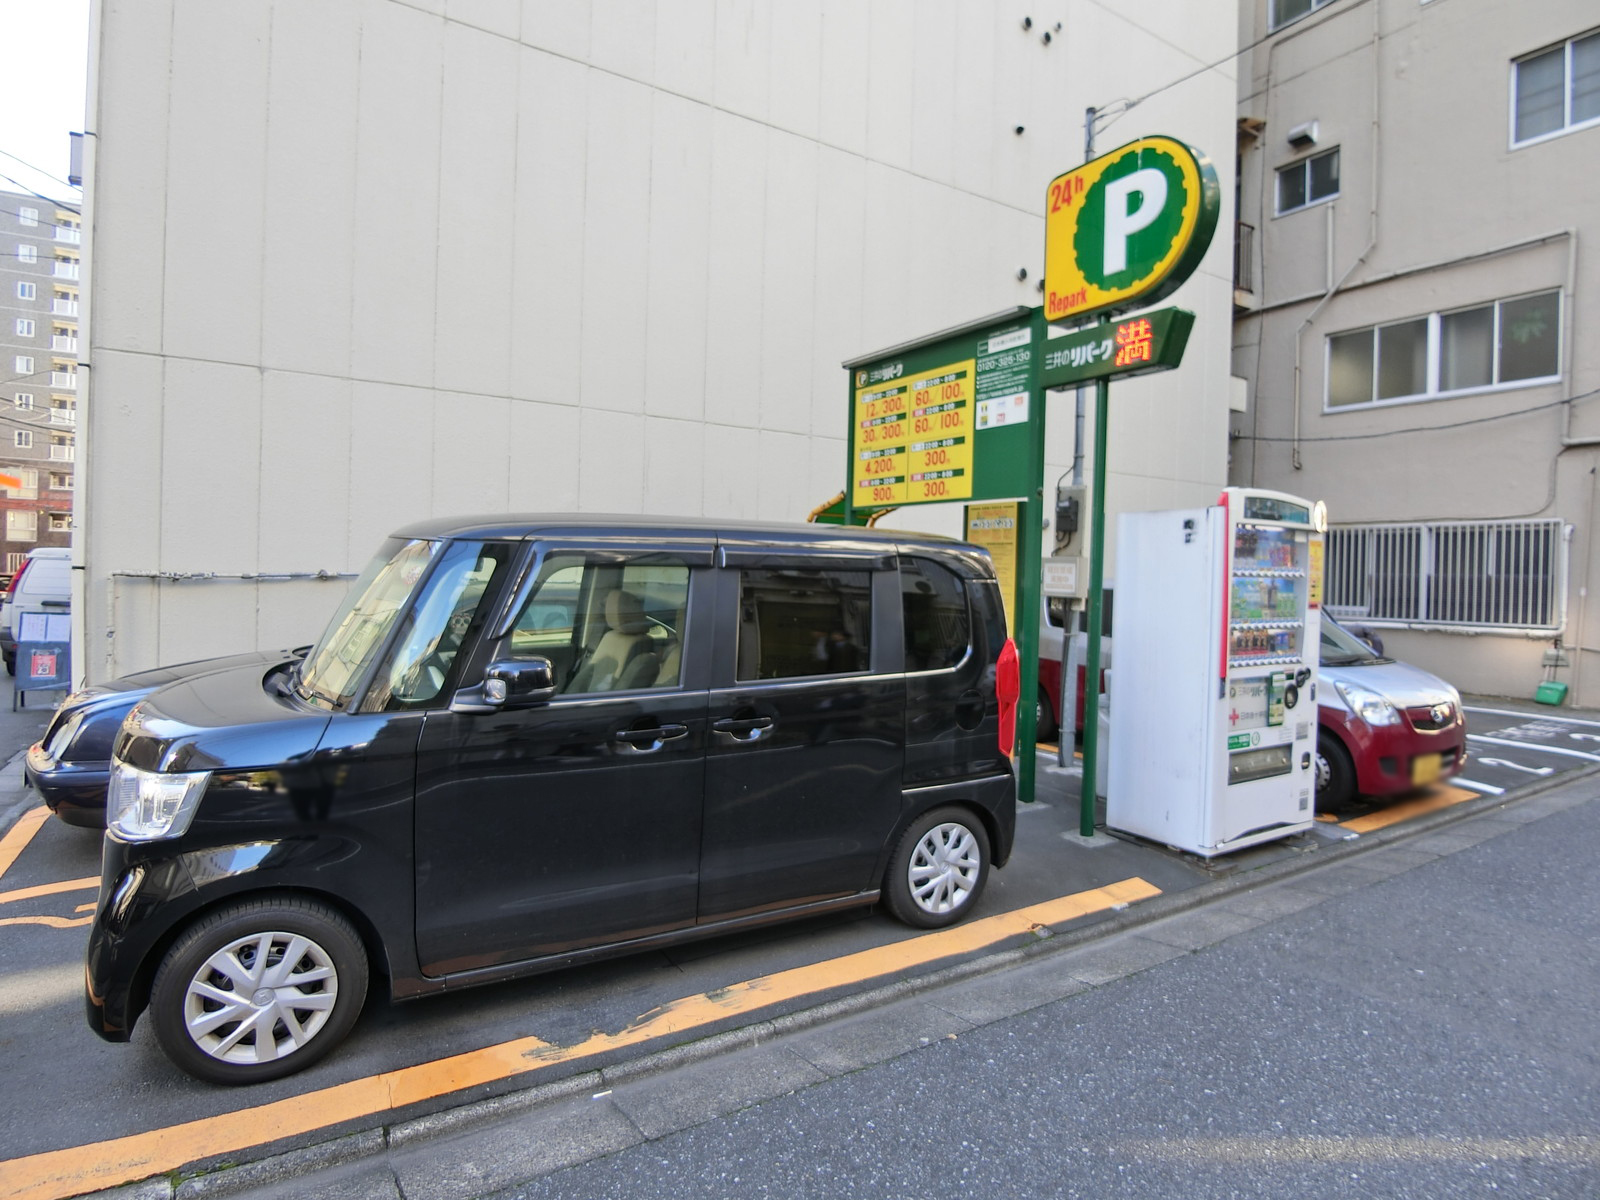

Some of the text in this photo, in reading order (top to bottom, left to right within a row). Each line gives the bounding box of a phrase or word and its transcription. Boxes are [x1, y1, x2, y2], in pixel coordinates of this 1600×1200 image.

[1103, 167, 1168, 277] P
[1048, 286, 1088, 314] Repark
[1115, 318, 1152, 367] 満
[1045, 339, 1113, 371] 三井のリパーク
[915, 390, 929, 406] 60
[941, 382, 960, 400] 100
[866, 403, 875, 418] 12
[883, 396, 902, 414] 300
[863, 428, 875, 443] 30
[882, 423, 901, 440] 300
[914, 417, 929, 434] 60
[941, 411, 960, 429] 100
[925, 449, 946, 467] 300
[873, 486, 892, 502] 900
[924, 480, 946, 498] 300
